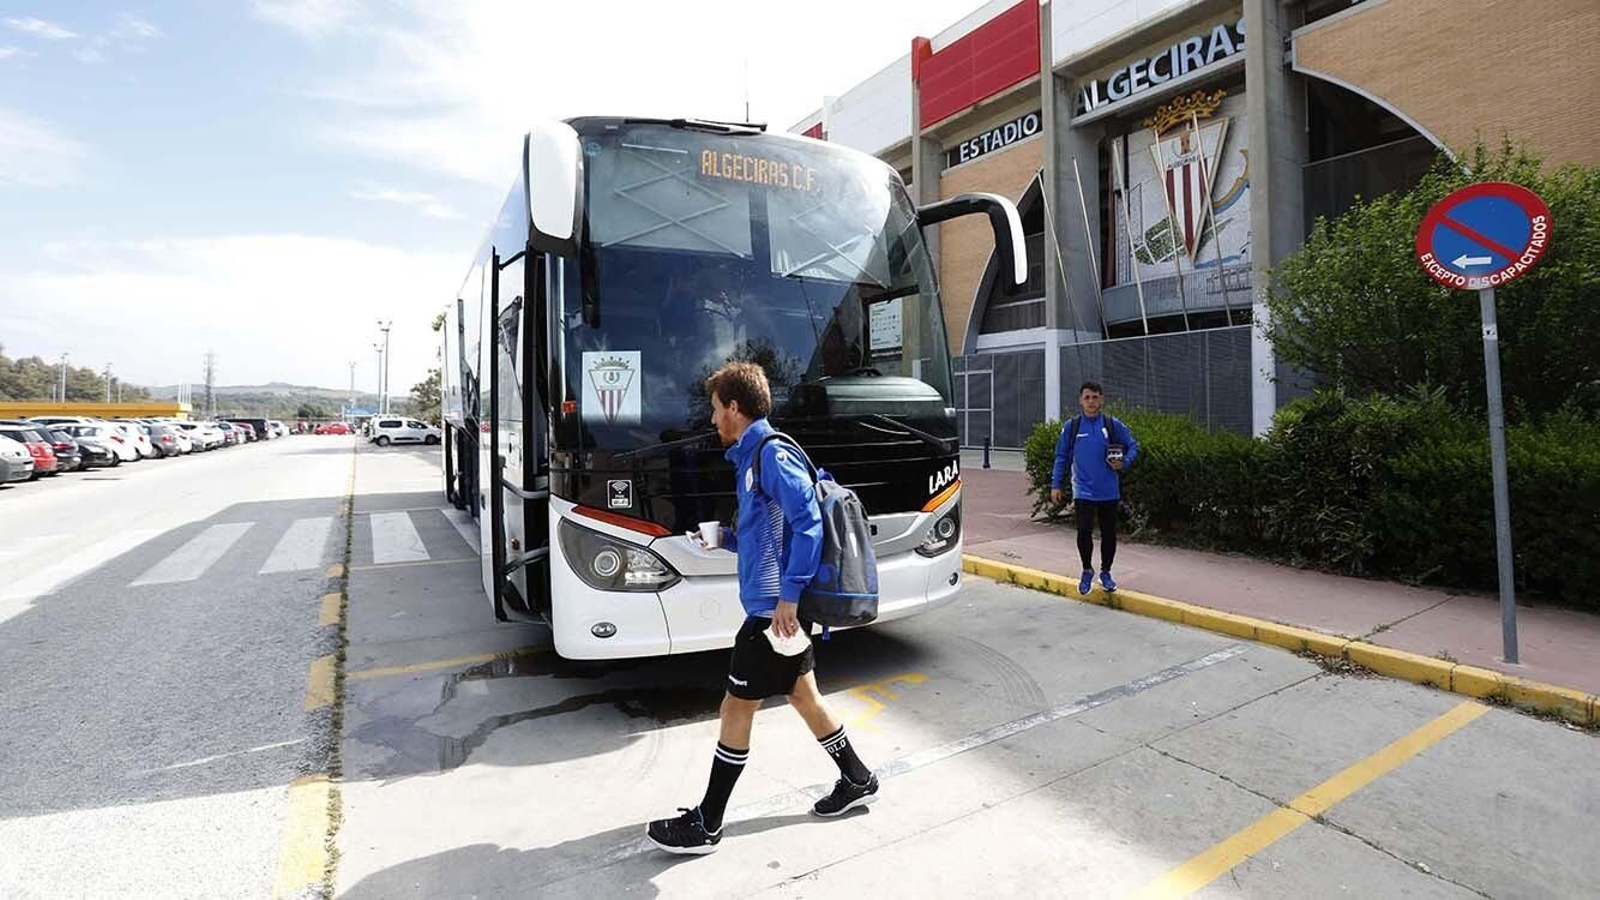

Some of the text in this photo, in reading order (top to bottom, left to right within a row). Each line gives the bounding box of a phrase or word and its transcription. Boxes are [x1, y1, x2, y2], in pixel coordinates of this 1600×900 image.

[960, 113, 1039, 163] ESTADIO
[701, 149, 788, 188] ALGECIRAS
[1420, 214, 1547, 288] EXCEPTO DISCAPACITADOS
[929, 460, 959, 495] LARA
[827, 738, 847, 754] OLO
